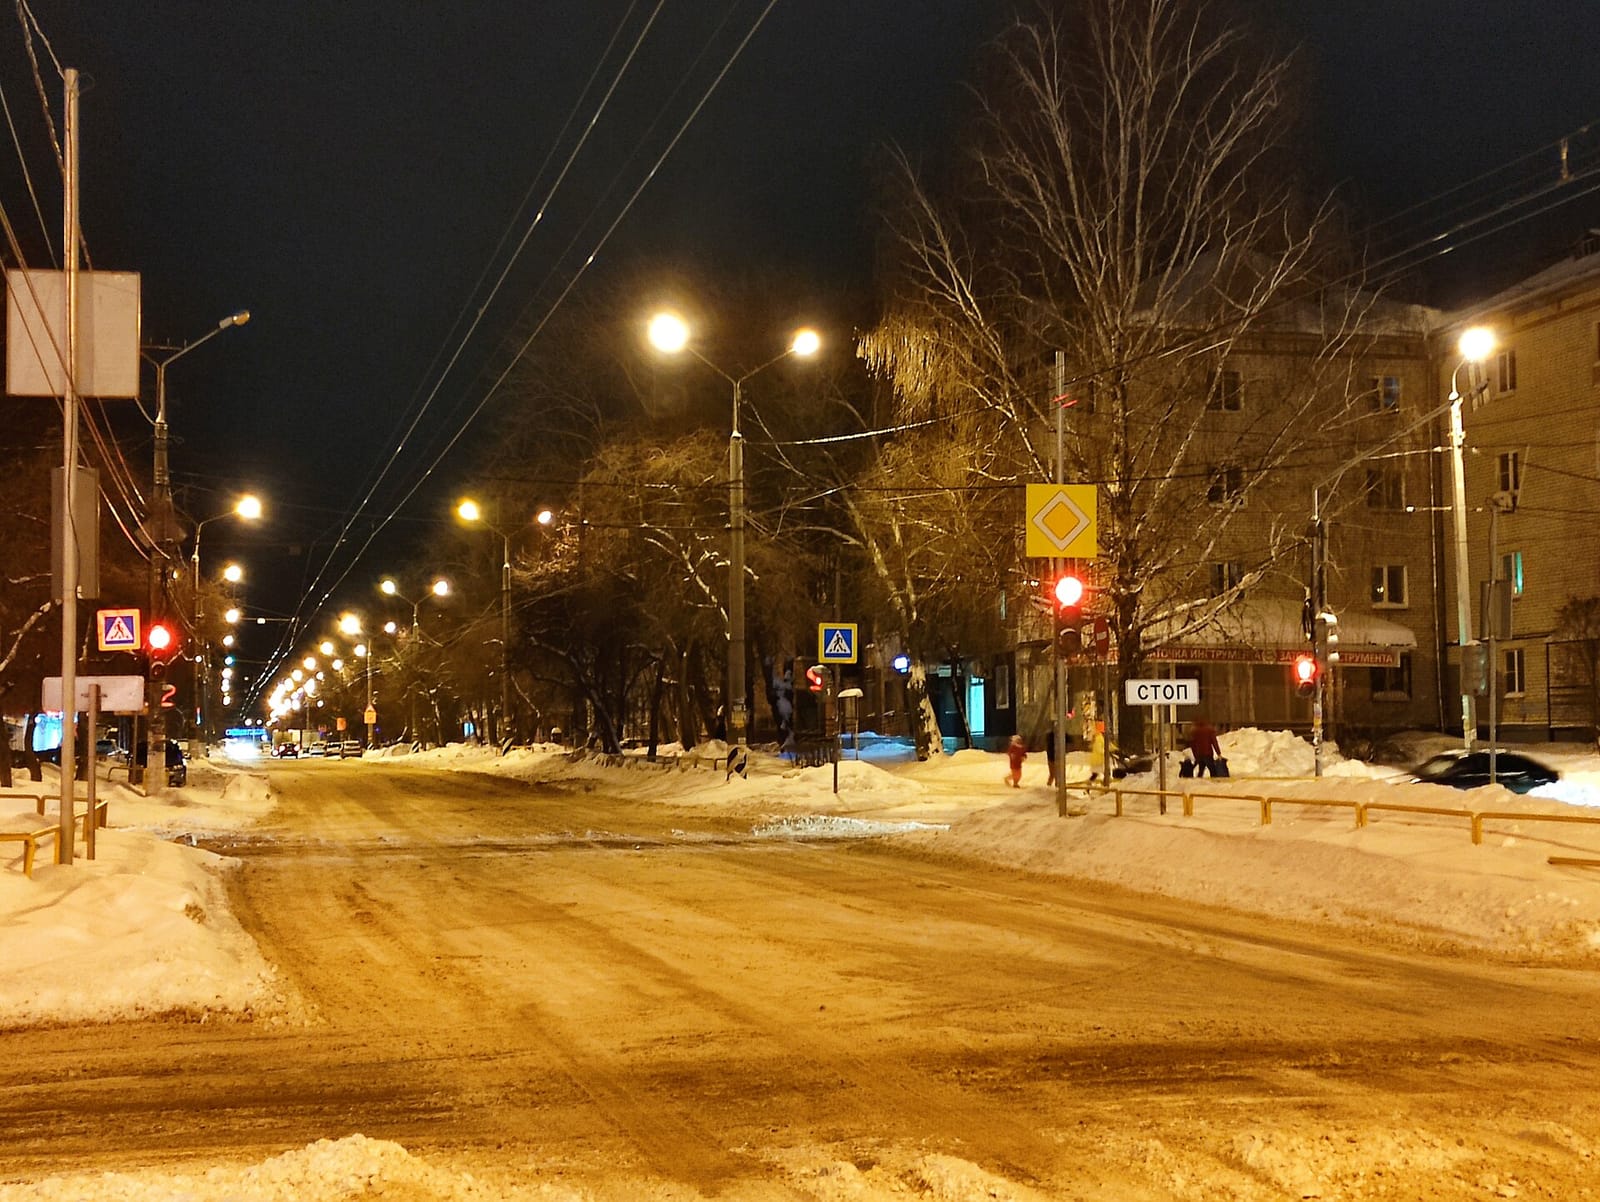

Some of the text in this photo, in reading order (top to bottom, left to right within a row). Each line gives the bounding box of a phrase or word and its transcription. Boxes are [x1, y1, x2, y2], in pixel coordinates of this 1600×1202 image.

[1146, 649, 1188, 660] АТОЧКА
[1190, 649, 1262, 661] ИНСТРУМЕНА
[1339, 653, 1393, 664] СТРУМЕНТА
[1137, 684, 1188, 700] СТОП
